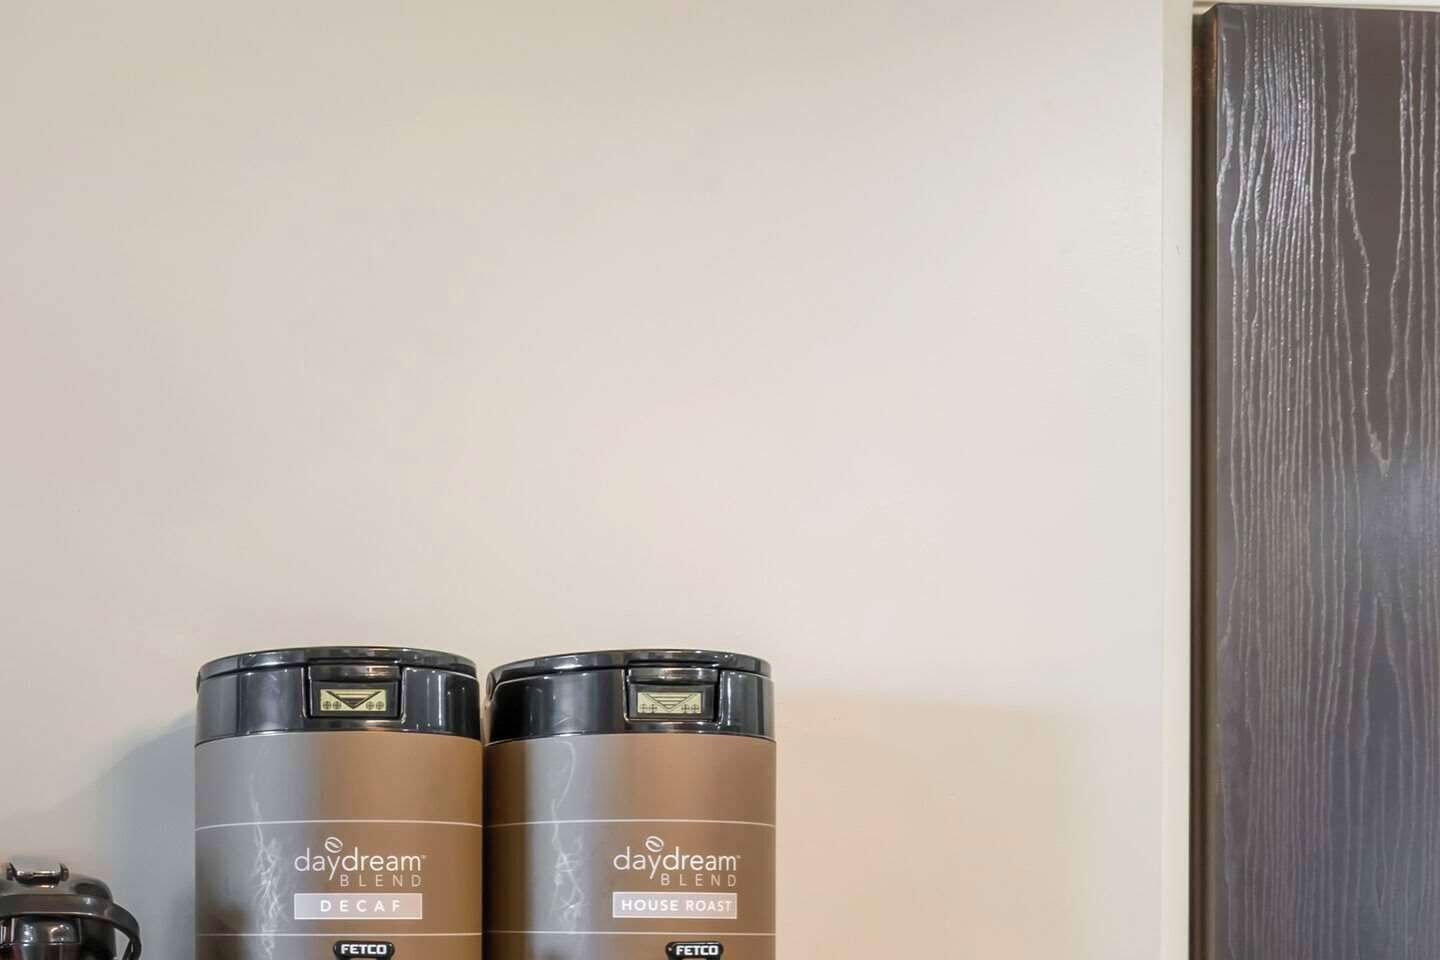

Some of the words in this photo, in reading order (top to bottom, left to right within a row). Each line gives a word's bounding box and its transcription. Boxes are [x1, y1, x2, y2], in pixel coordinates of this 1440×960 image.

[294, 846, 421, 880] daydream
[613, 846, 737, 880] daydream
[340, 874, 422, 887] BLEND
[661, 873, 737, 887] BLEND
[320, 899, 401, 912] DECAF
[621, 899, 679, 911] HOUSE
[686, 900, 733, 911] ROAST
[341, 944, 387, 954] FETCO
[676, 945, 719, 955] FETCO
